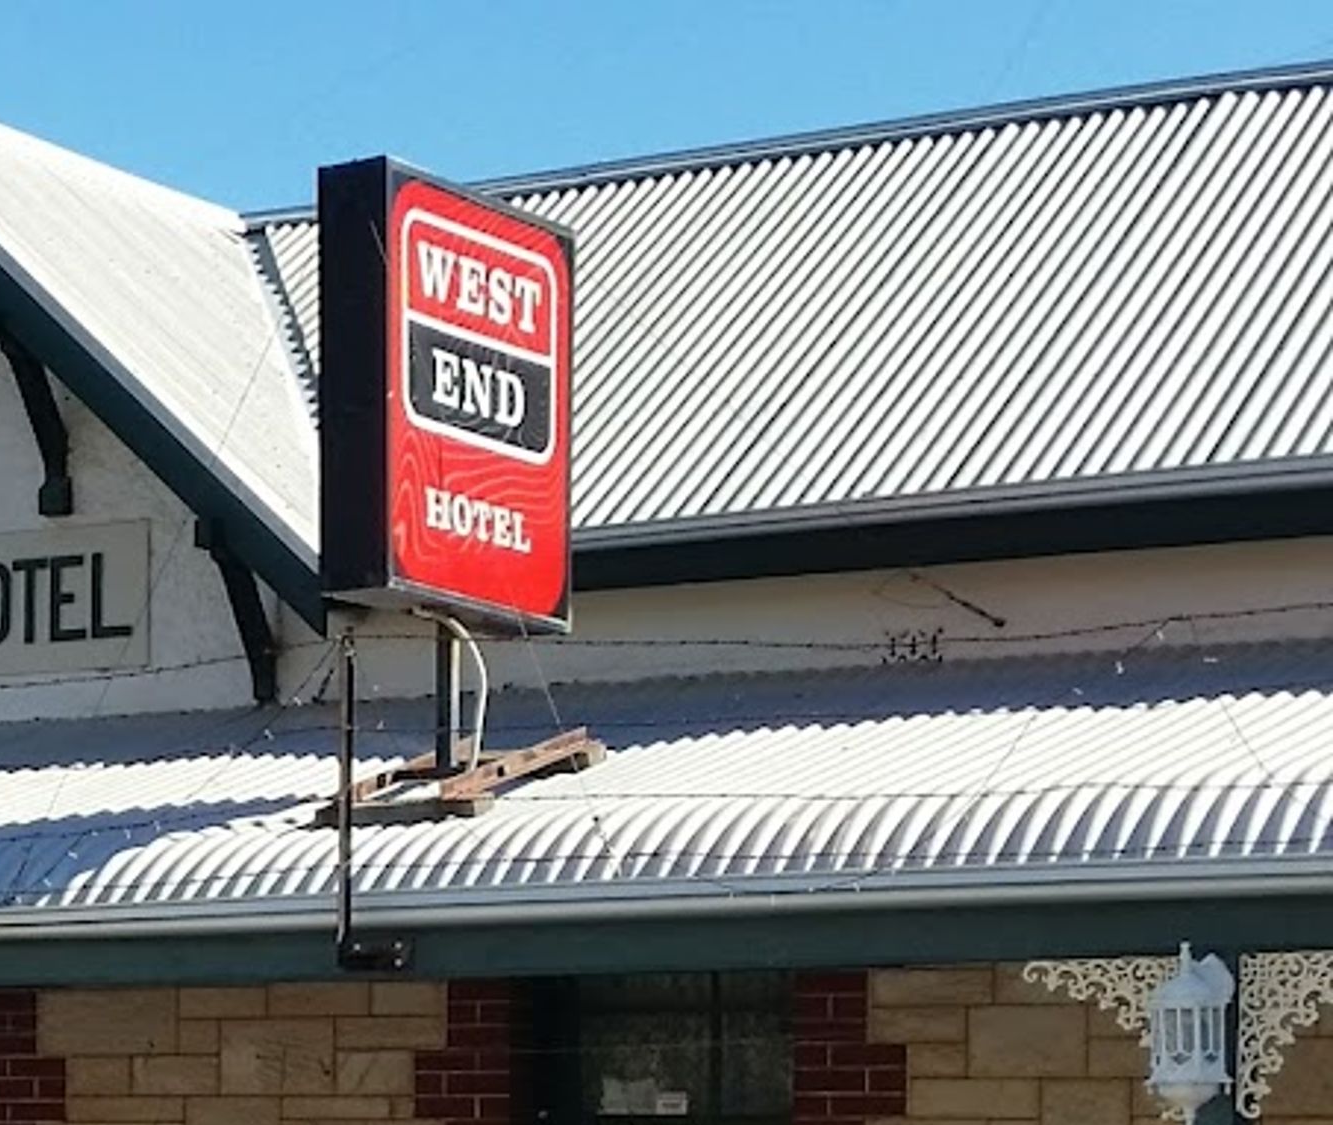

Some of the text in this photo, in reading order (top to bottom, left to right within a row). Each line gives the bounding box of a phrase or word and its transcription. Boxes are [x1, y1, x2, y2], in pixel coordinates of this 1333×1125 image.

[416, 240, 542, 333] WEST
[432, 348, 525, 428] END
[425, 485, 532, 555] HOTEL
